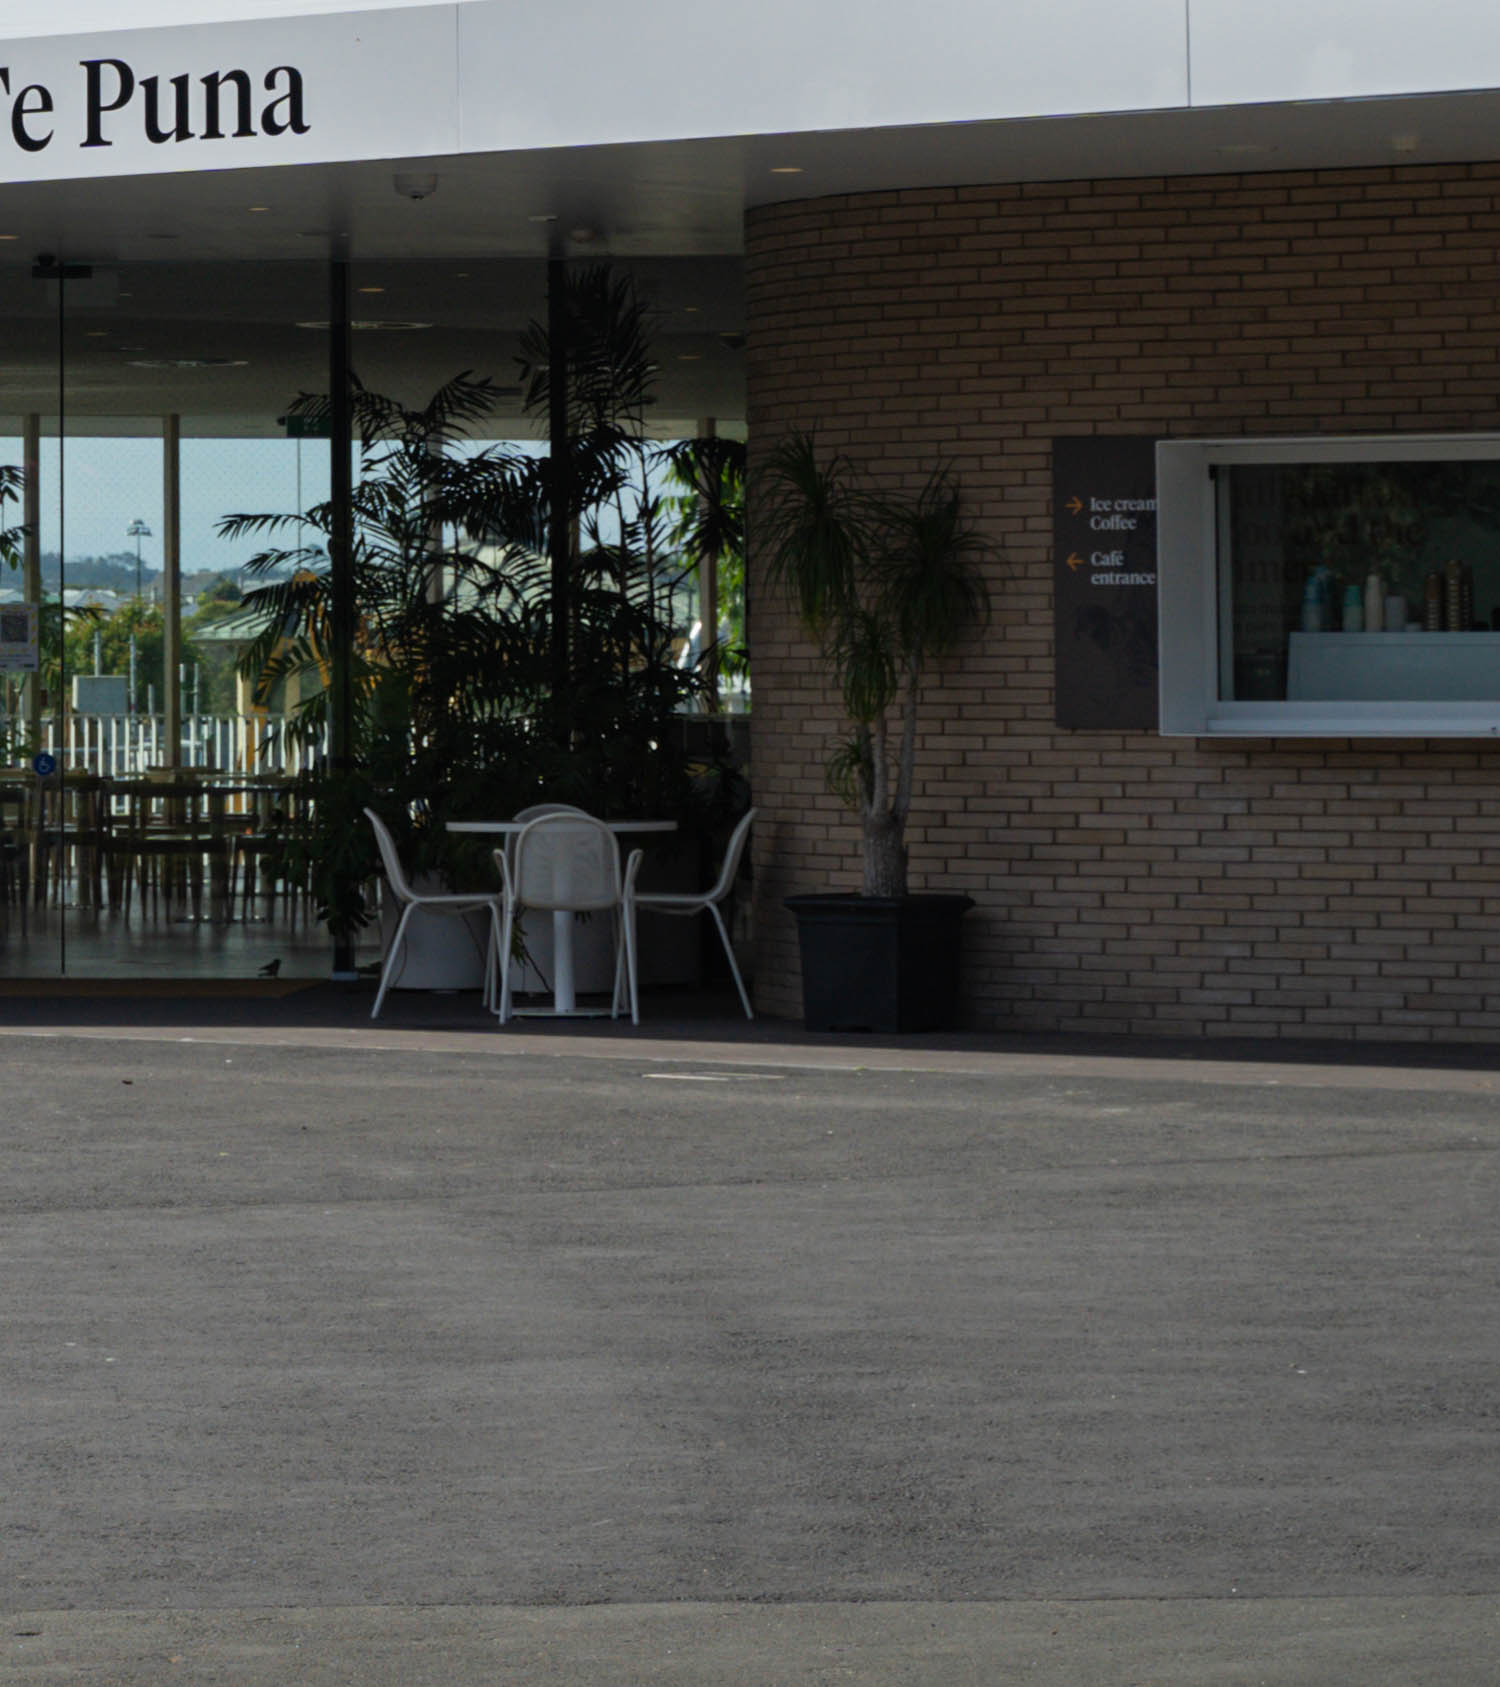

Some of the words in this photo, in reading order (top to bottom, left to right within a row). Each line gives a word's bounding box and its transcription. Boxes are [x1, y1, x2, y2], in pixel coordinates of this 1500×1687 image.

[79, 58, 311, 148] Puna
[1090, 496, 1112, 511] Ice
[1114, 499, 1157, 511] cream
[1090, 514, 1136, 530] Coffee
[1091, 550, 1124, 566] Café
[1091, 571, 1156, 585] entrance
